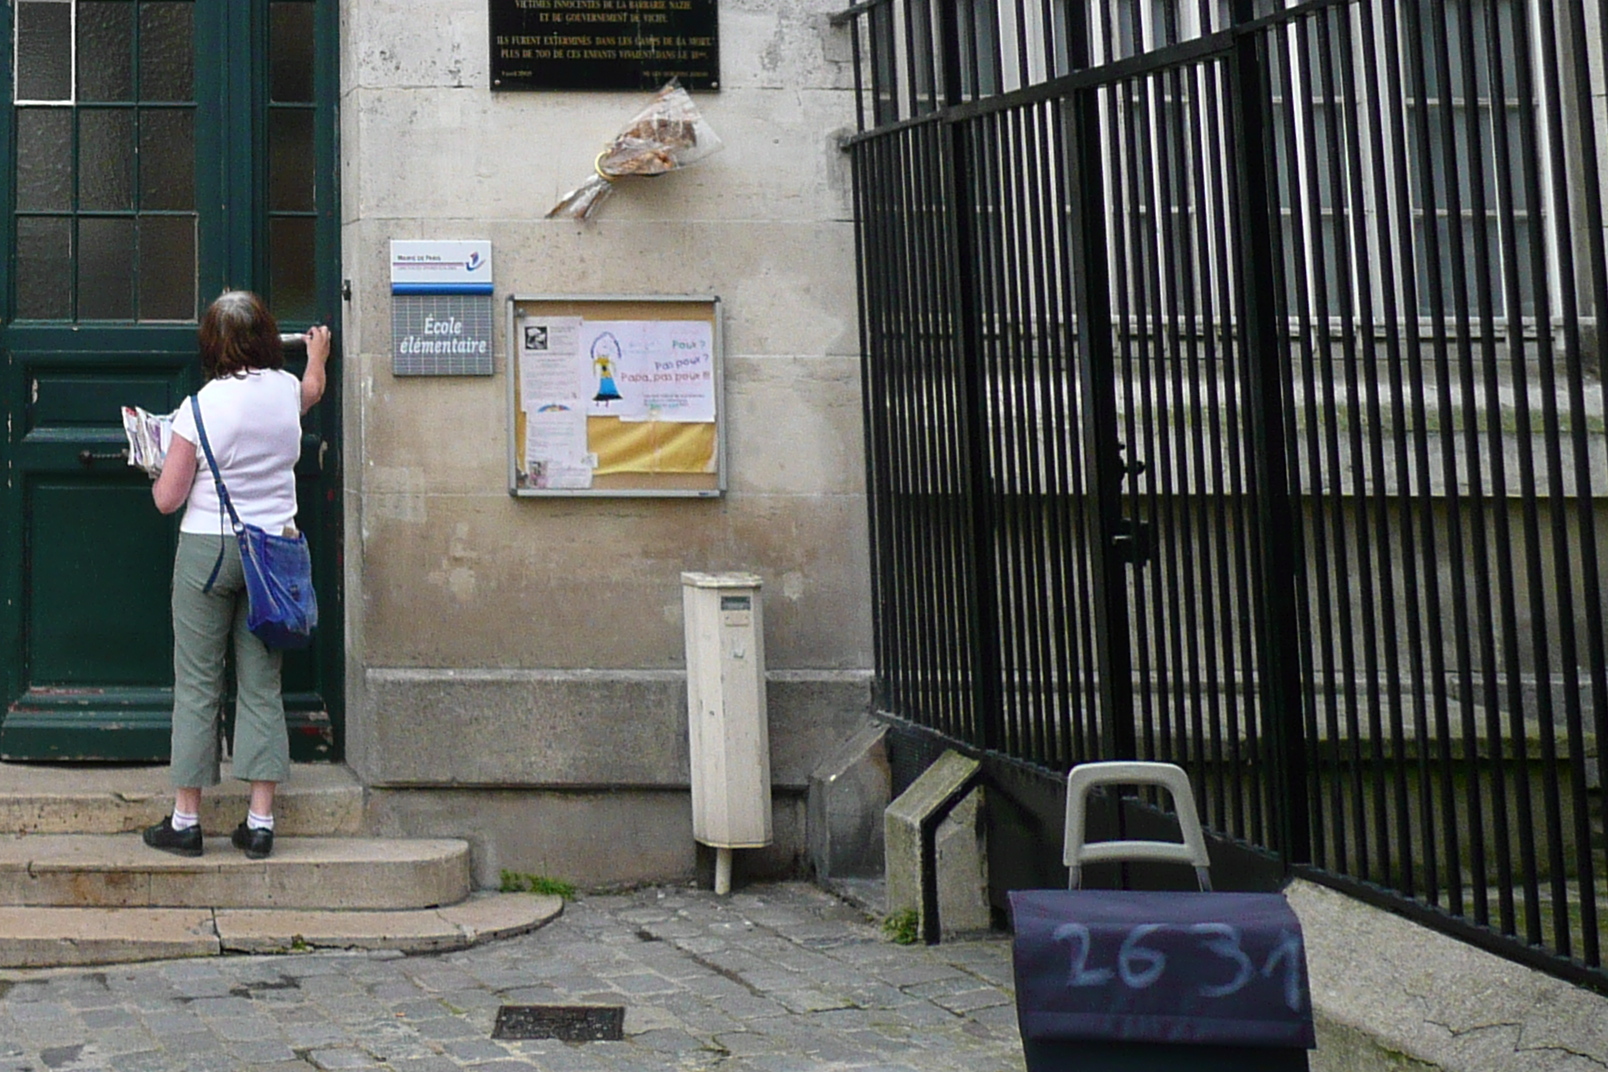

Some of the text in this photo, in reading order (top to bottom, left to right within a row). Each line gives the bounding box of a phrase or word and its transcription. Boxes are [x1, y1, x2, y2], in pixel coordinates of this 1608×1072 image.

[515, 0, 551, 9] VICTIMES
[553, 0, 601, 9] INNOCENTES
[603, 0, 614, 9] DE
[616, 0, 627, 9] LA
[629, 0, 666, 9] BARBARIE
[539, 13, 550, 22] ET
[552, 13, 562, 22] DU
[565, 13, 628, 22] GOUVERNEMENT
[630, 14, 640, 23] DE
[497, 36, 509, 45] ILS
[511, 36, 540, 45] FURENT
[595, 36, 616, 46] DANS
[618, 36, 632, 46] LES
[663, 36, 673, 46] DE
[501, 49, 520, 59] PLUS
[522, 49, 532, 59] DE
[553, 49, 564, 59] DE
[566, 49, 581, 59] CES
[583, 49, 616, 59] ENFANTS
[655, 50, 676, 59] DANS
[677, 50, 687, 59] LE
[424, 313, 462, 334] École
[400, 336, 487, 354] élémentaire
[1052, 922, 1301, 1013] 2631
